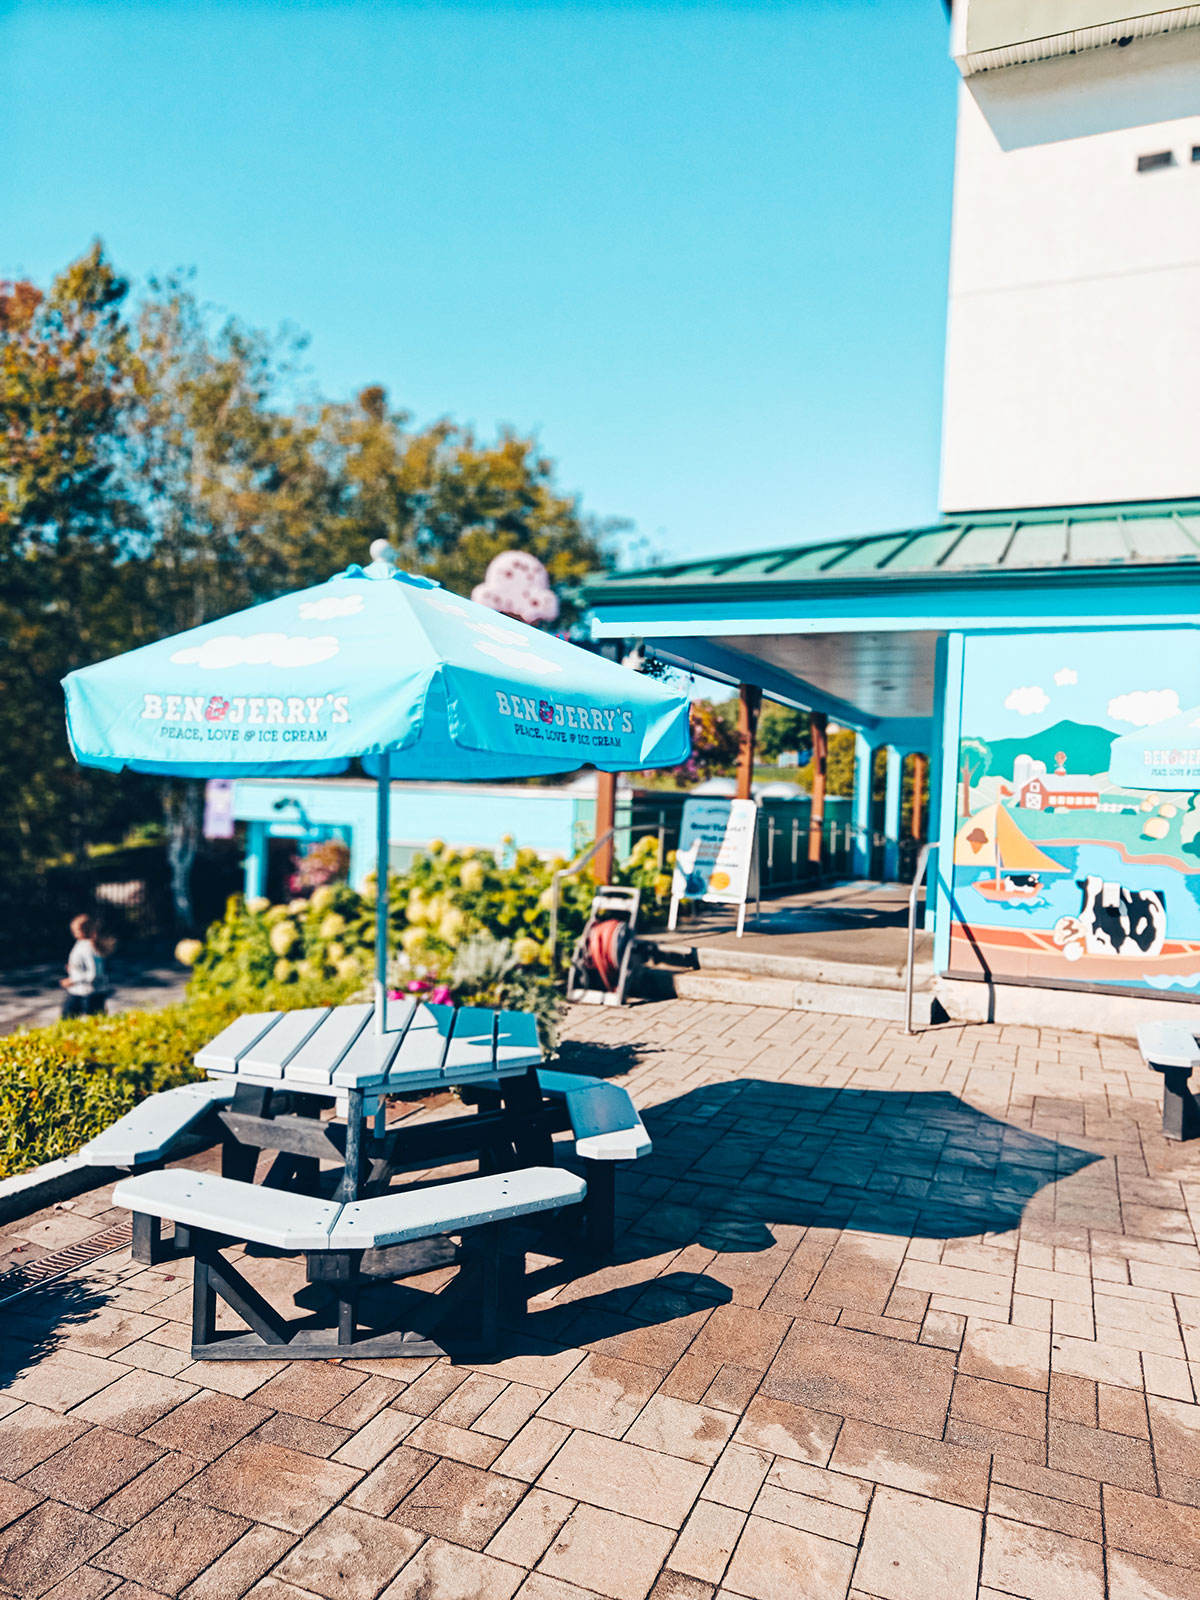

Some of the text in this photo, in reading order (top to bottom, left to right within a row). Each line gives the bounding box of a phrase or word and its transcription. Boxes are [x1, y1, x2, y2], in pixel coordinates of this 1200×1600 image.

[160, 726, 328, 742] PEACE, LOVE & ICE CREAM
[545, 729, 567, 743] LOVE
[577, 734, 591, 745] ICE
[592, 736, 621, 747] CREAM
